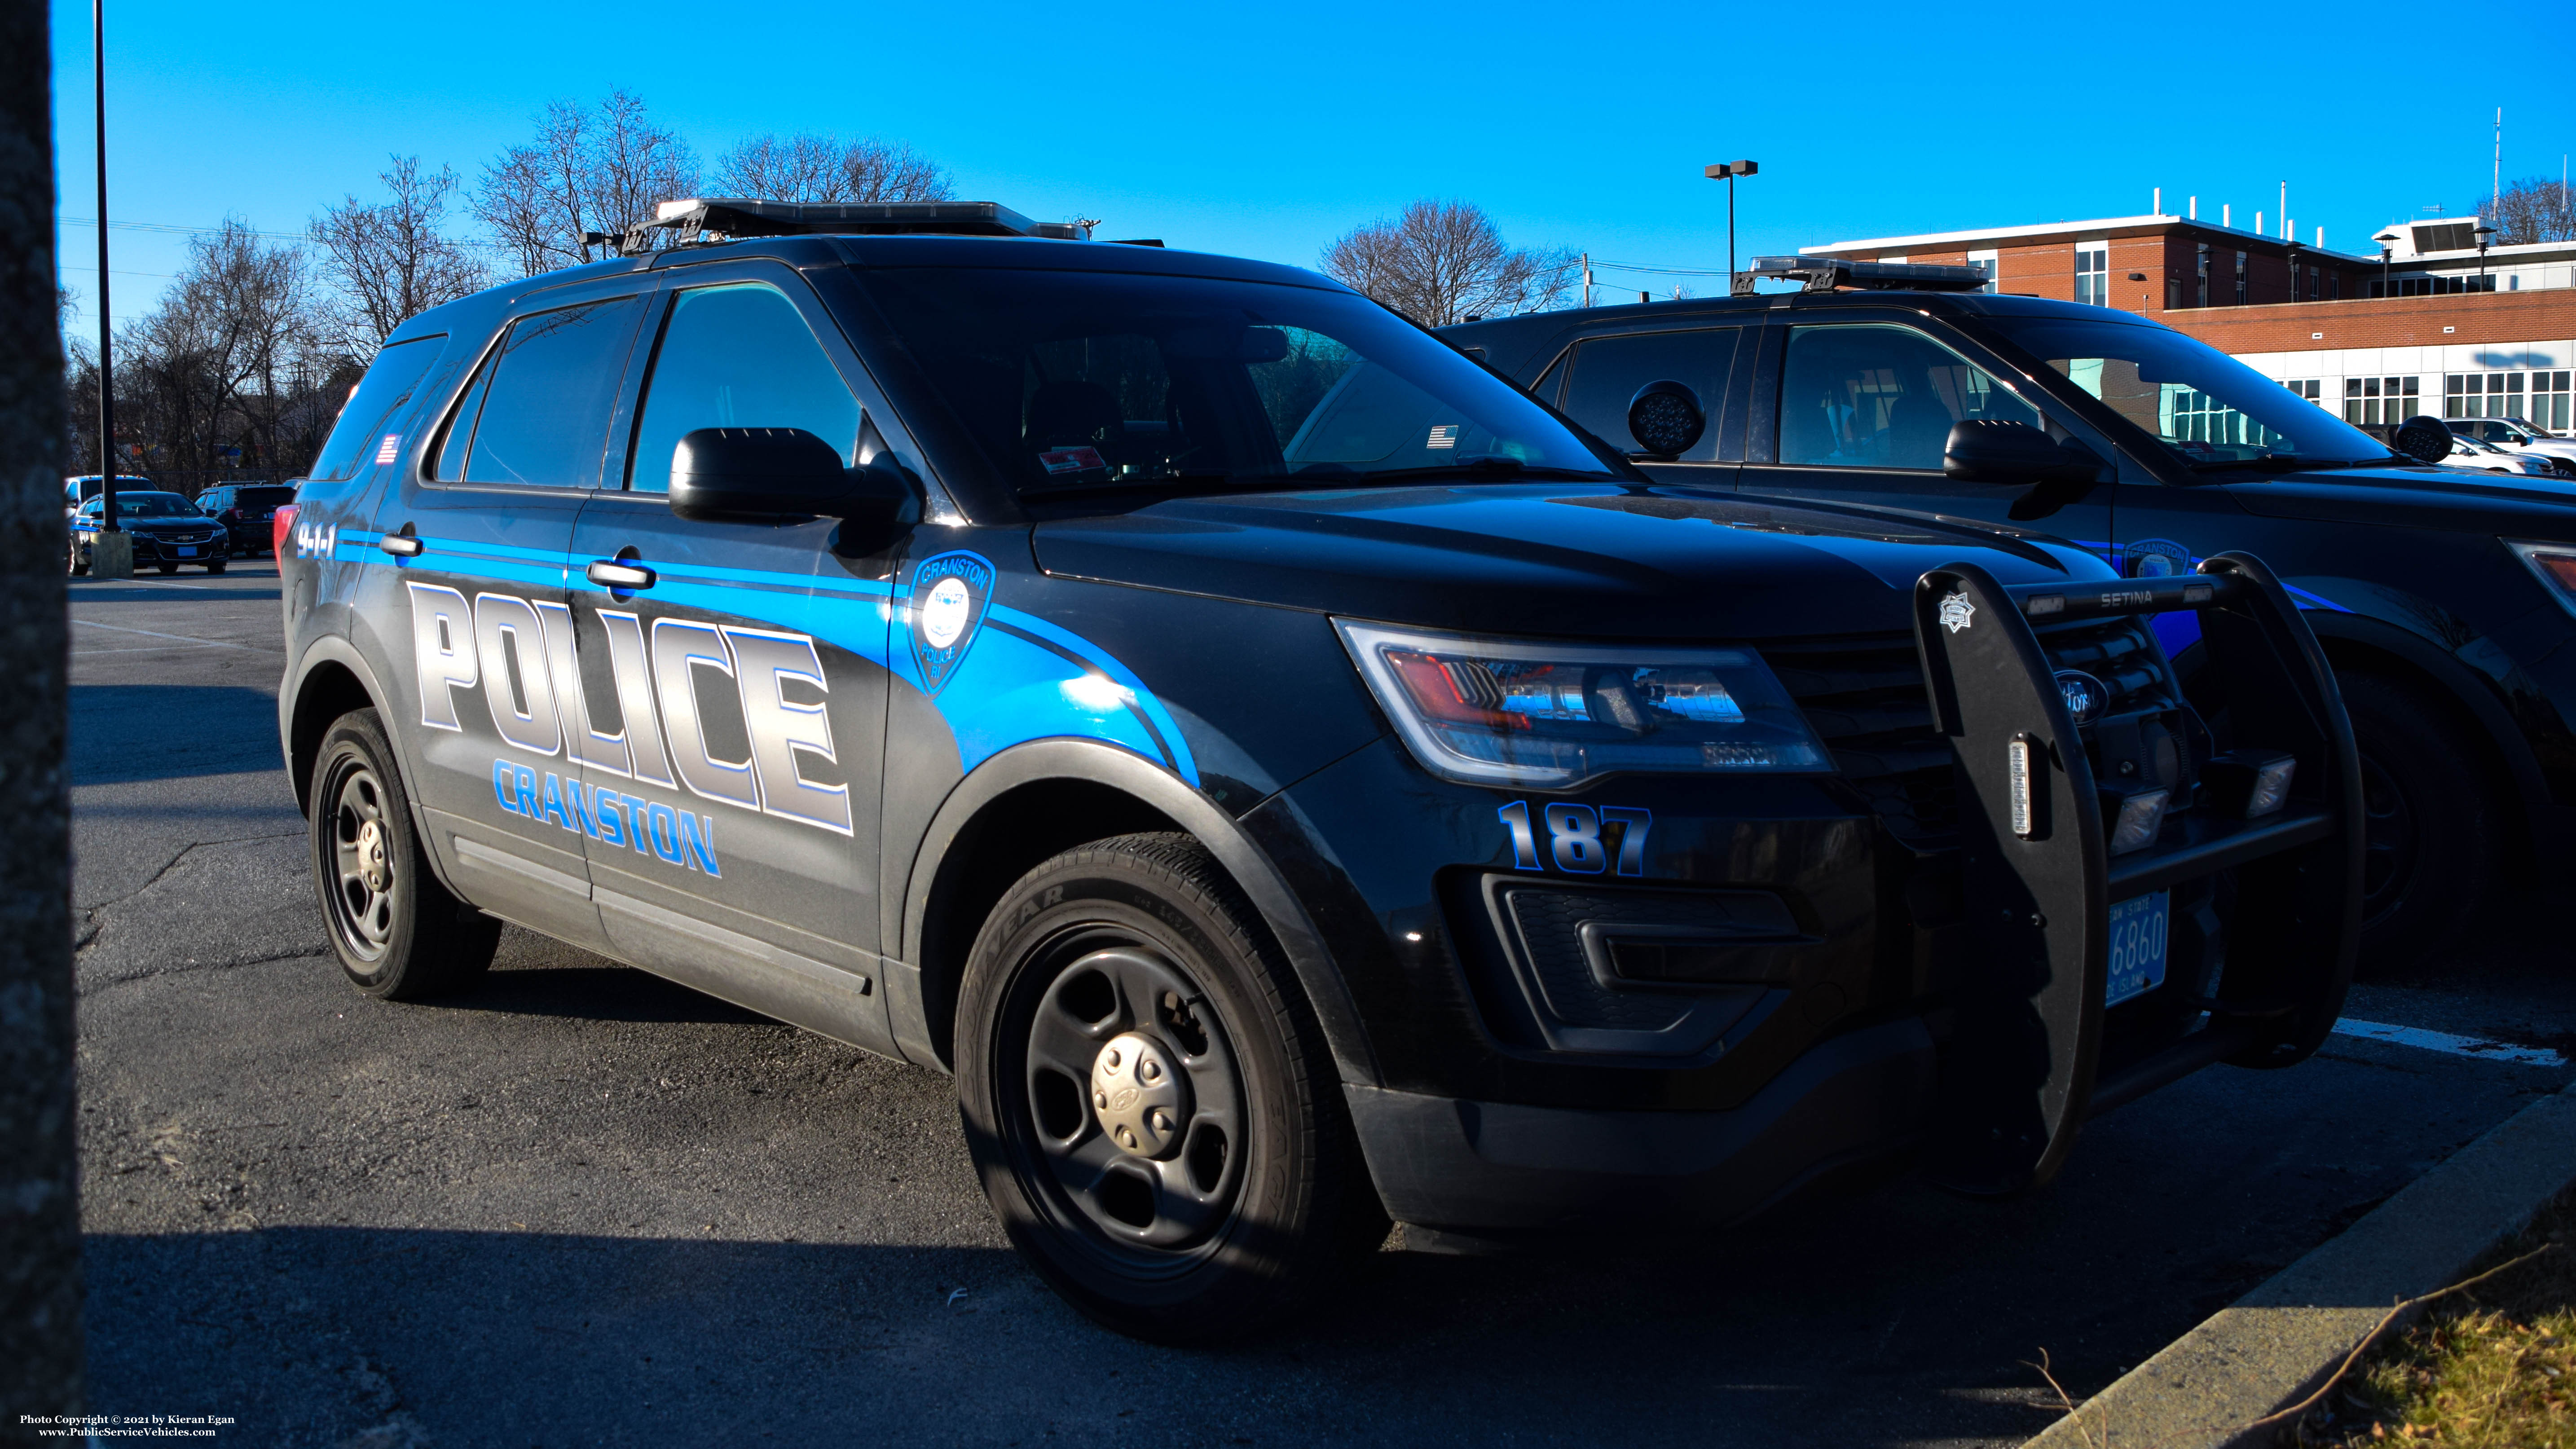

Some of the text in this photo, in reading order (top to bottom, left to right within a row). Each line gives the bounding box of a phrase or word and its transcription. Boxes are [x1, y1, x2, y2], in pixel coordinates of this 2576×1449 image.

[297, 521, 337, 560] 9-1-1
[2130, 543, 2184, 562] CRANSTON
[921, 558, 988, 590] CRANSTON
[2101, 590, 2152, 607] SETINA
[921, 643, 956, 664] POLICE
[931, 665, 941, 678] RI
[406, 580, 854, 837] POLICE
[2061, 683, 2099, 713] Ford
[493, 758, 722, 878] CRANSTON
[1498, 800, 1653, 877] 187
[2127, 896, 2150, 916] STATE
[2112, 911, 2163, 976] 6860
